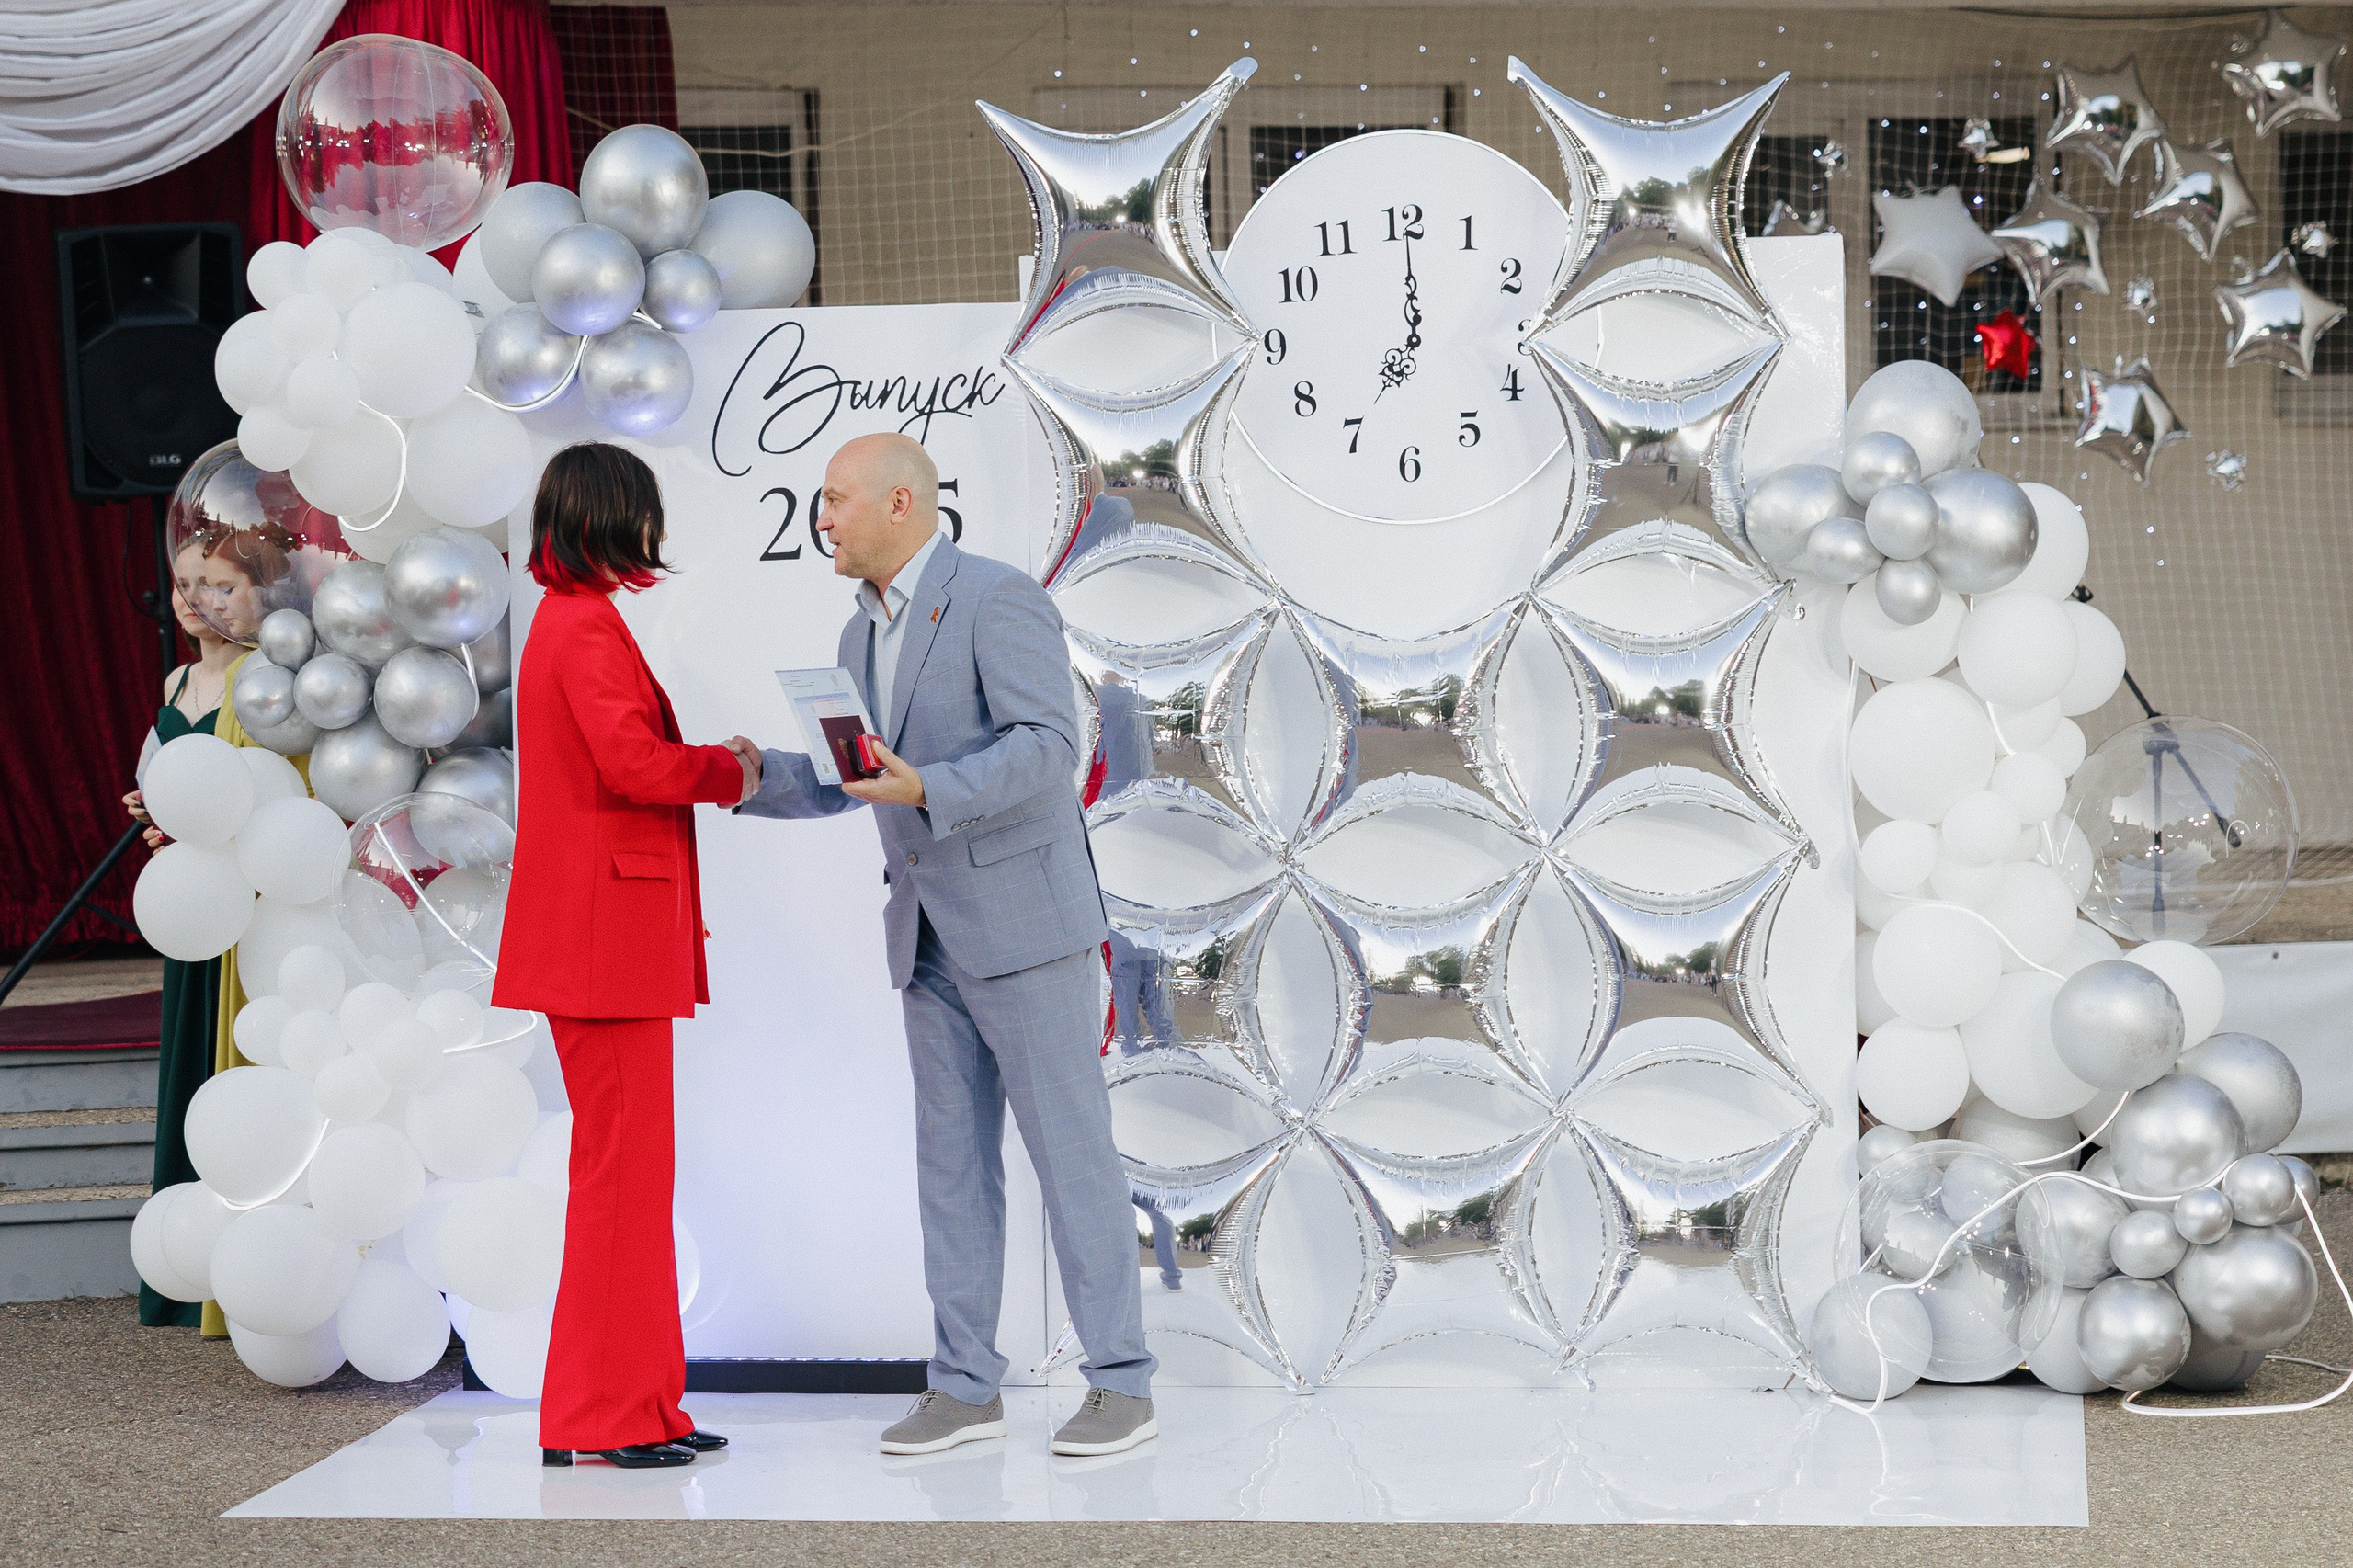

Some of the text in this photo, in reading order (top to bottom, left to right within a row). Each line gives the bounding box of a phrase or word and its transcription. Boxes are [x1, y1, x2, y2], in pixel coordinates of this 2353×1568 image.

[1314, 219, 1358, 257] 11
[1381, 204, 1425, 242] 12
[1459, 215, 1479, 251] 1
[1278, 265, 1319, 304] 10
[1500, 257, 1522, 295] 2
[1264, 328, 1287, 366] 9
[1293, 381, 1317, 417] 8
[1499, 363, 1525, 402] 4
[1342, 415, 1365, 454] 7
[1458, 409, 1481, 448] 5
[1399, 446, 1421, 483] 6
[759, 478, 963, 562] 205
